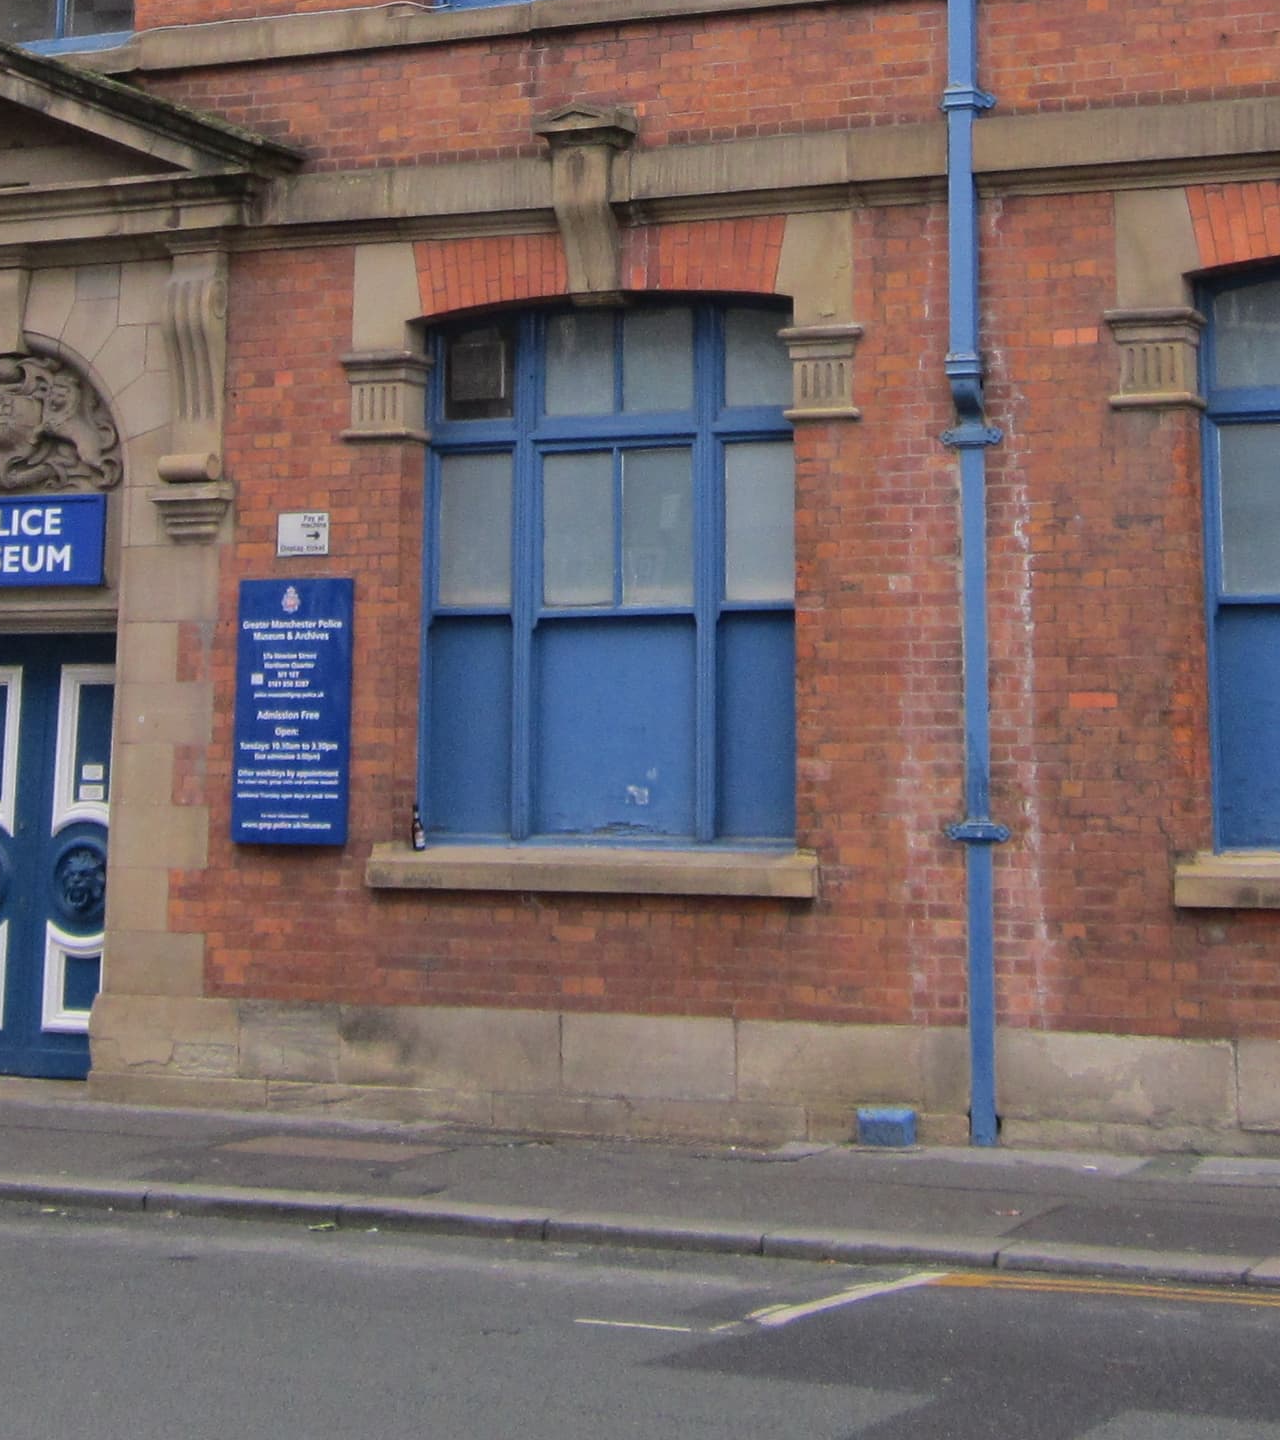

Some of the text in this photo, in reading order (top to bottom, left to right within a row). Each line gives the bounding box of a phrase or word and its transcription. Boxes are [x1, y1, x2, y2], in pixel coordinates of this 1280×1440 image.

[243, 619, 343, 629] Greater Manchester Police
[253, 631, 329, 641] Museum & Archives
[257, 709, 320, 720] Admission Free
[275, 726, 299, 737] Open:
[302, 742, 310, 750] to
